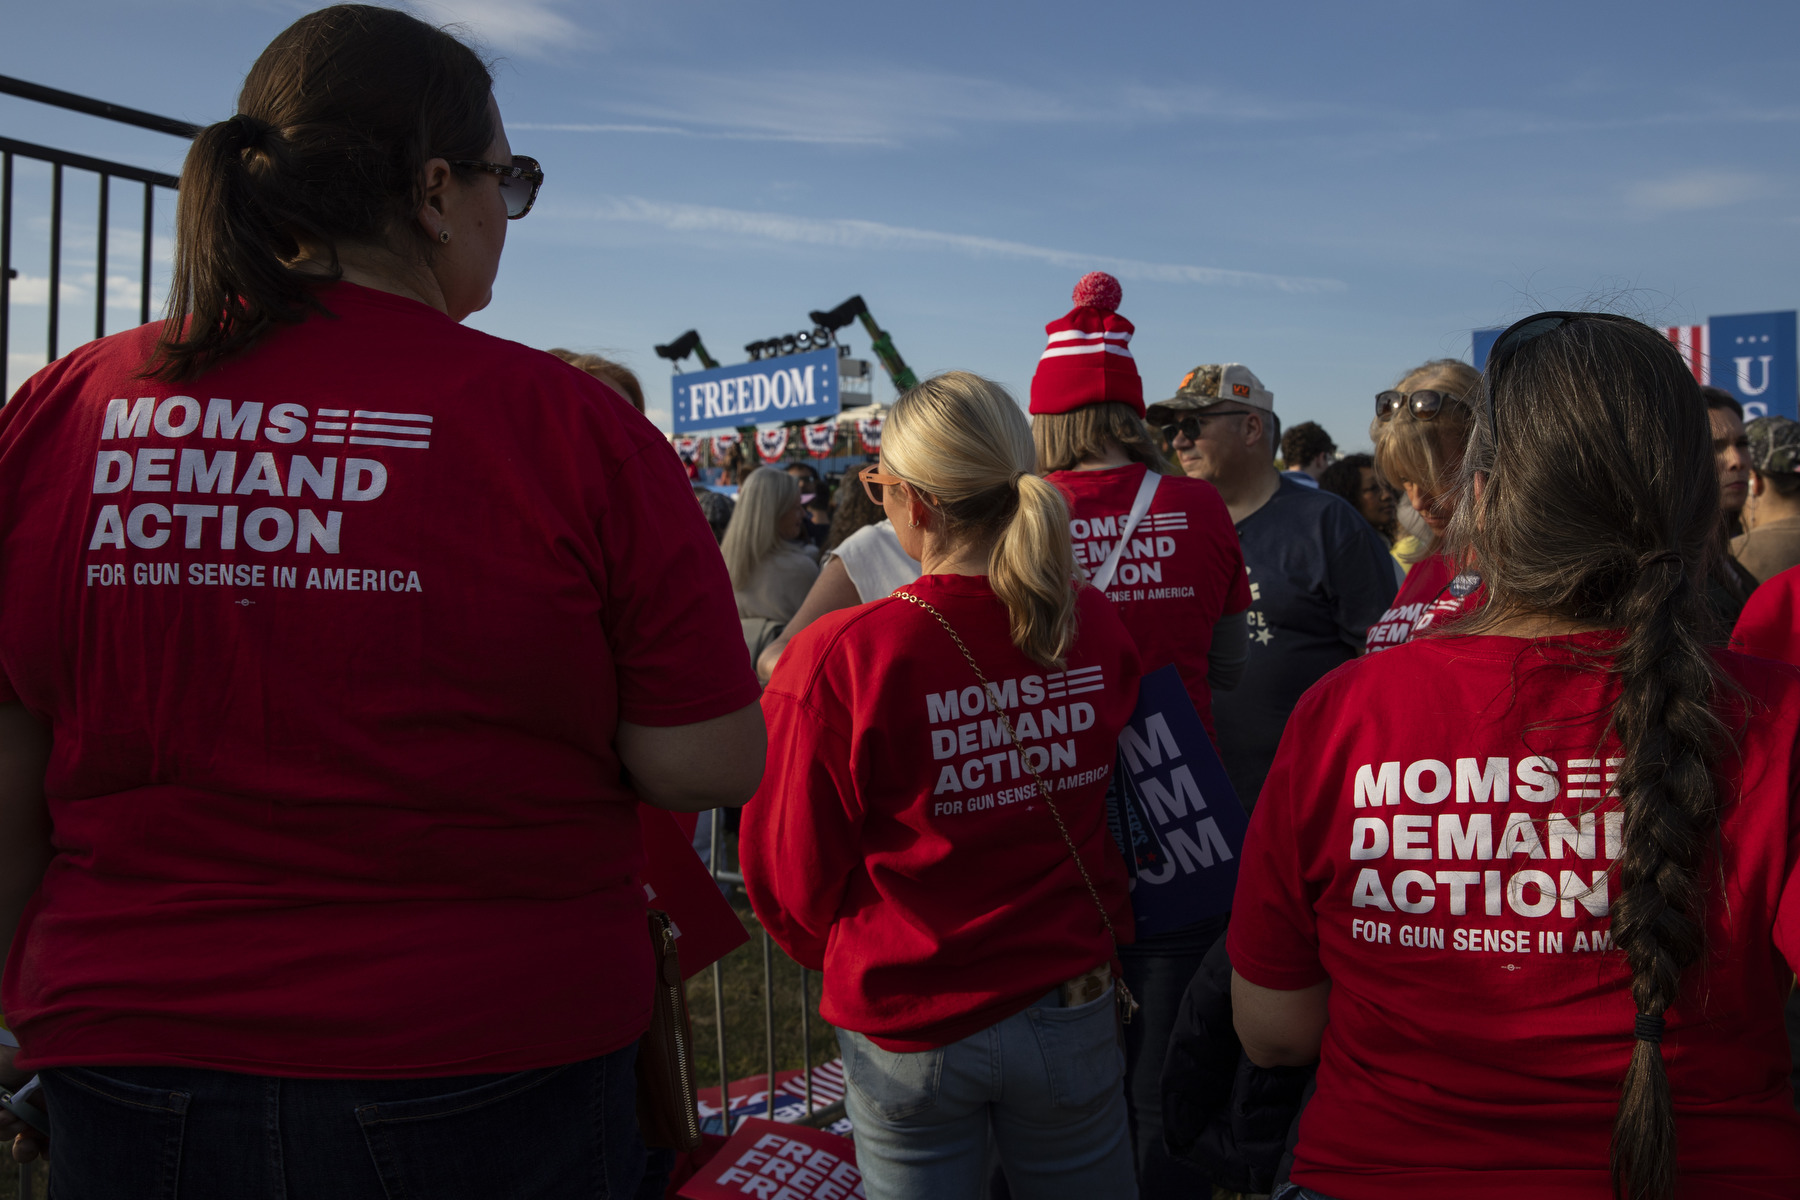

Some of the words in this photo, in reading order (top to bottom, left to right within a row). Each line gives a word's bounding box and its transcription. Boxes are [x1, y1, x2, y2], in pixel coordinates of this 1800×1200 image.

[689, 365, 816, 421] FREEDOM
[101, 395, 309, 444] MOMS
[92, 447, 388, 502] DEMAND
[88, 502, 343, 555] ACTION
[1070, 515, 1130, 540] OMS
[1072, 536, 1176, 565] EMAND
[87, 563, 127, 587] FOR
[133, 562, 180, 586] GUN
[188, 563, 266, 587] SENSE
[273, 566, 297, 589] IN
[305, 568, 423, 593] AMERICA
[1105, 590, 1132, 602] ENSE
[1133, 589, 1145, 601] IN
[1147, 586, 1195, 600] AMERICA
[926, 675, 1046, 724] MOMS
[931, 701, 1096, 760] DEMAND
[933, 739, 1077, 795] ACTION
[934, 801, 963, 816] FOR
[967, 793, 995, 812] GUN
[997, 782, 1037, 806] SENSE
[1056, 764, 1109, 791] AMERICA
[1353, 756, 1561, 808] MOMS
[1351, 867, 1609, 918] ACTION
[1352, 918, 1392, 945] FOR
[1399, 925, 1445, 949] GUN
[1452, 928, 1531, 953] SENSE
[1538, 931, 1563, 954] IN
[1572, 930, 1624, 953] AM
[753, 1132, 866, 1197] FREE
